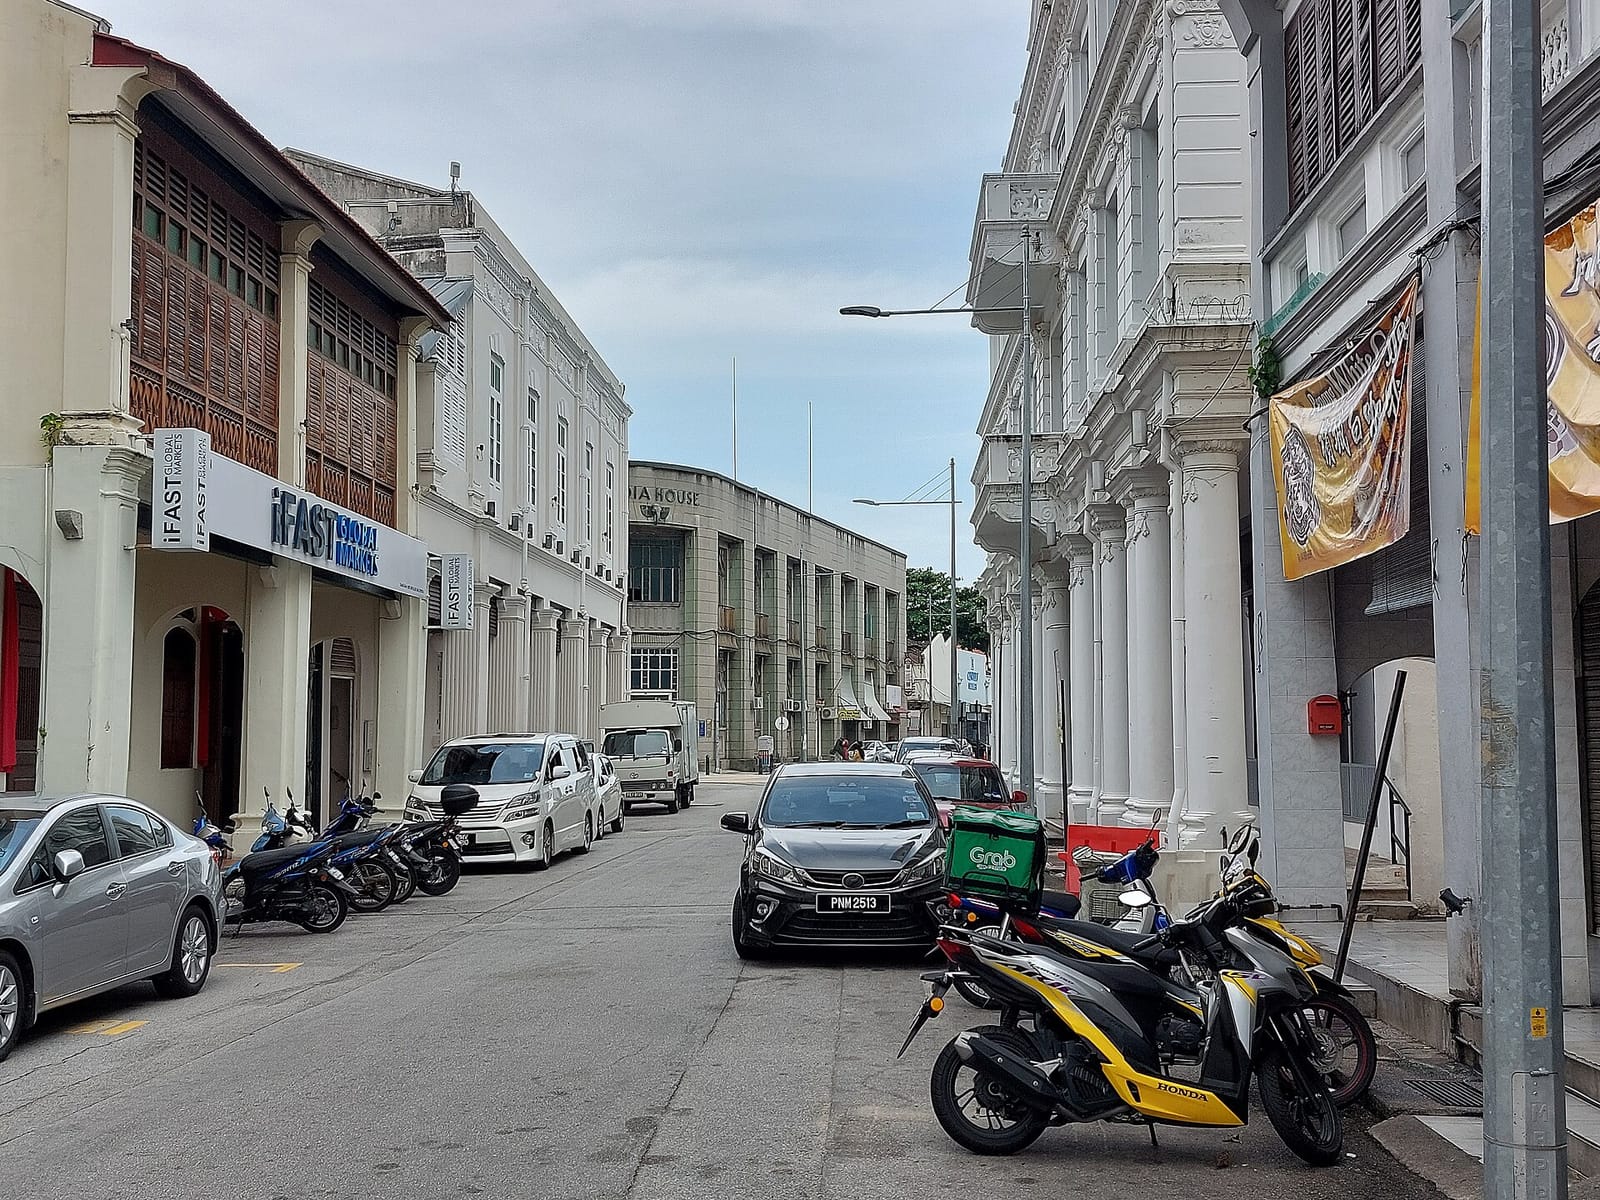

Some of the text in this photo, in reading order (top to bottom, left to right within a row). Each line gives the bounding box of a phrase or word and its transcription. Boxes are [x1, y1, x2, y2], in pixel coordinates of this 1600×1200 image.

[1370, 315, 1411, 368] Cffee
[165, 433, 174, 476] GLOBAL
[174, 433, 183, 475] MARKETS
[163, 476, 182, 543] iFAST
[197, 478, 206, 545] iFAST
[655, 487, 700, 507] HOUSE
[271, 486, 338, 561] iFAST
[336, 513, 378, 551] GLOBAL
[335, 540, 379, 577] MARKETS
[448, 583, 460, 625] iFAST
[969, 846, 1017, 869] Grab
[831, 896, 877, 909] PNM 2513
[1157, 1082, 1209, 1102] HONDA
